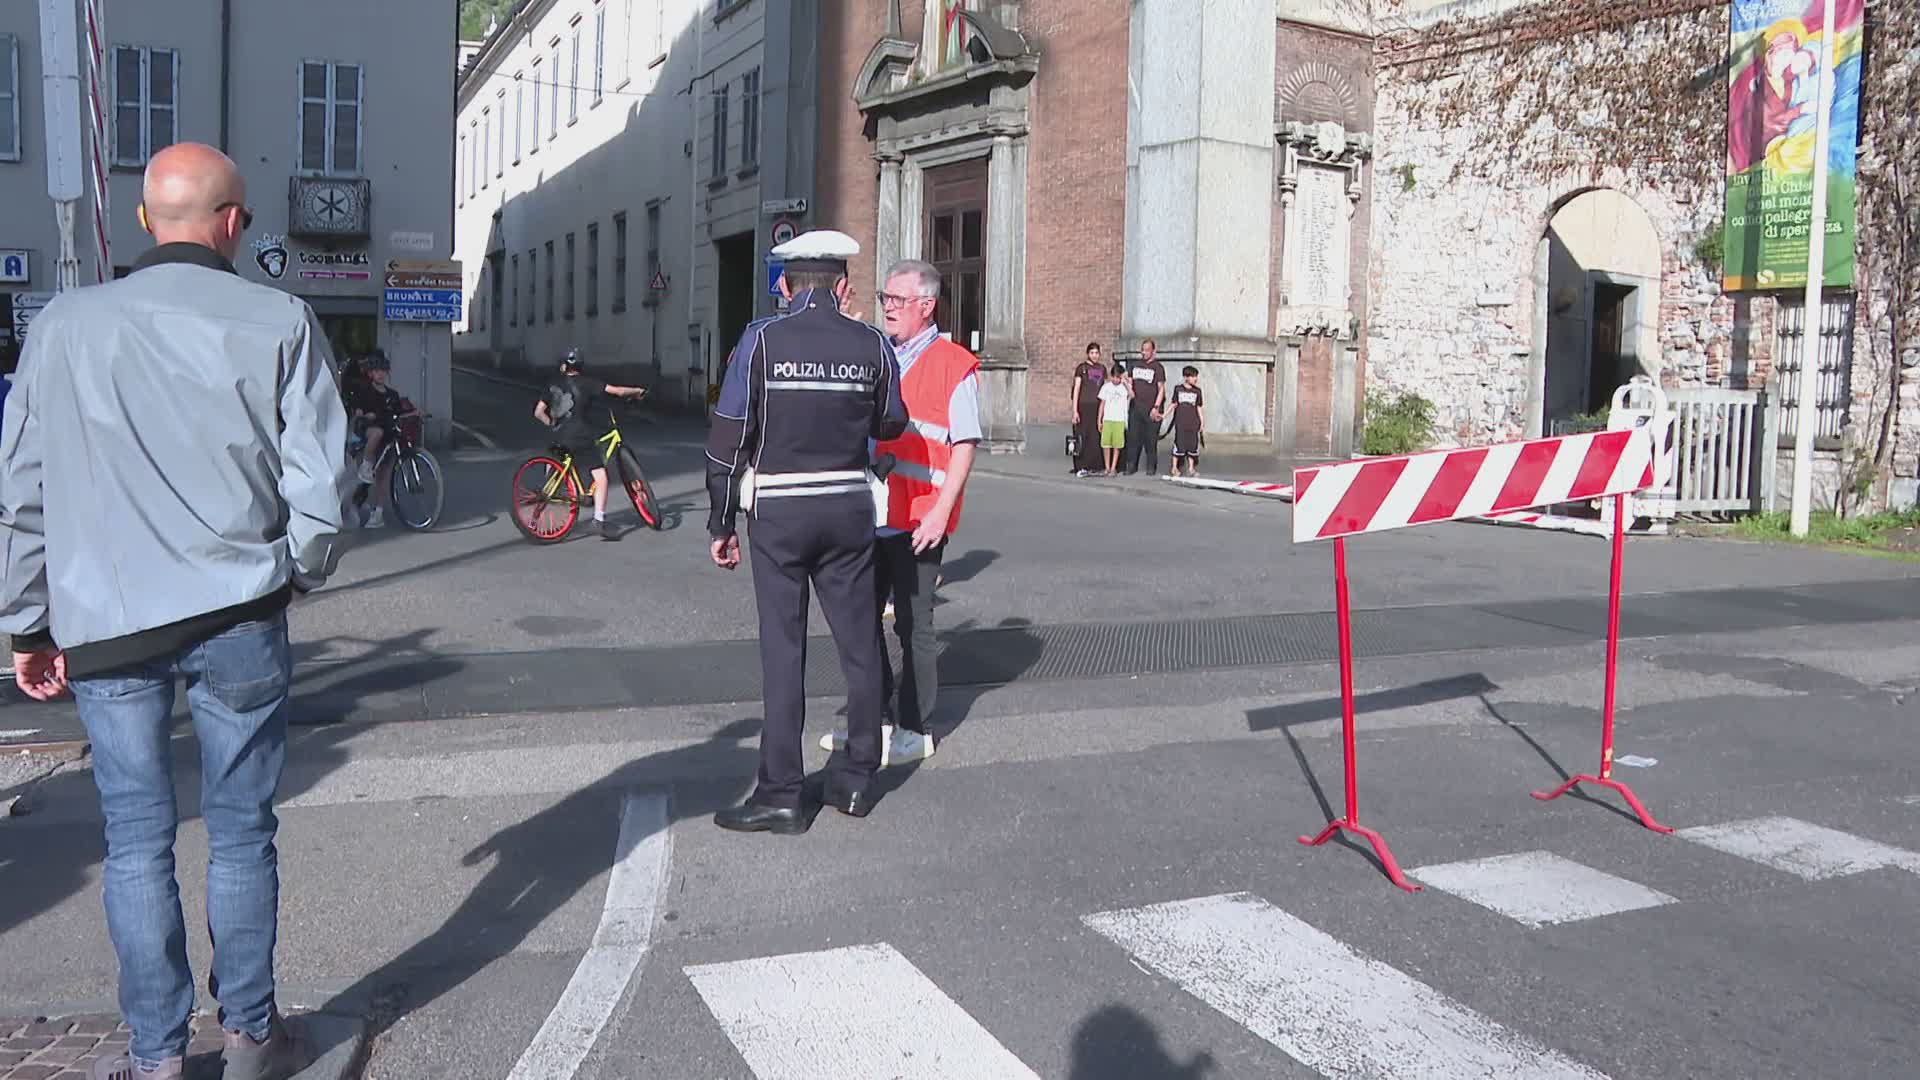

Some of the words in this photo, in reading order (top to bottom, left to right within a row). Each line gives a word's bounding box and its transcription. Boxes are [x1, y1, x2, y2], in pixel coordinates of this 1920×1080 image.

[1765, 208, 1809, 226] pellegr
[1765, 223, 1778, 239] di
[1780, 221, 1843, 240] sperza
[386, 291, 434, 302] BRUNATE
[774, 361, 825, 378] POLIZIA
[830, 362, 876, 380] LOCALE
